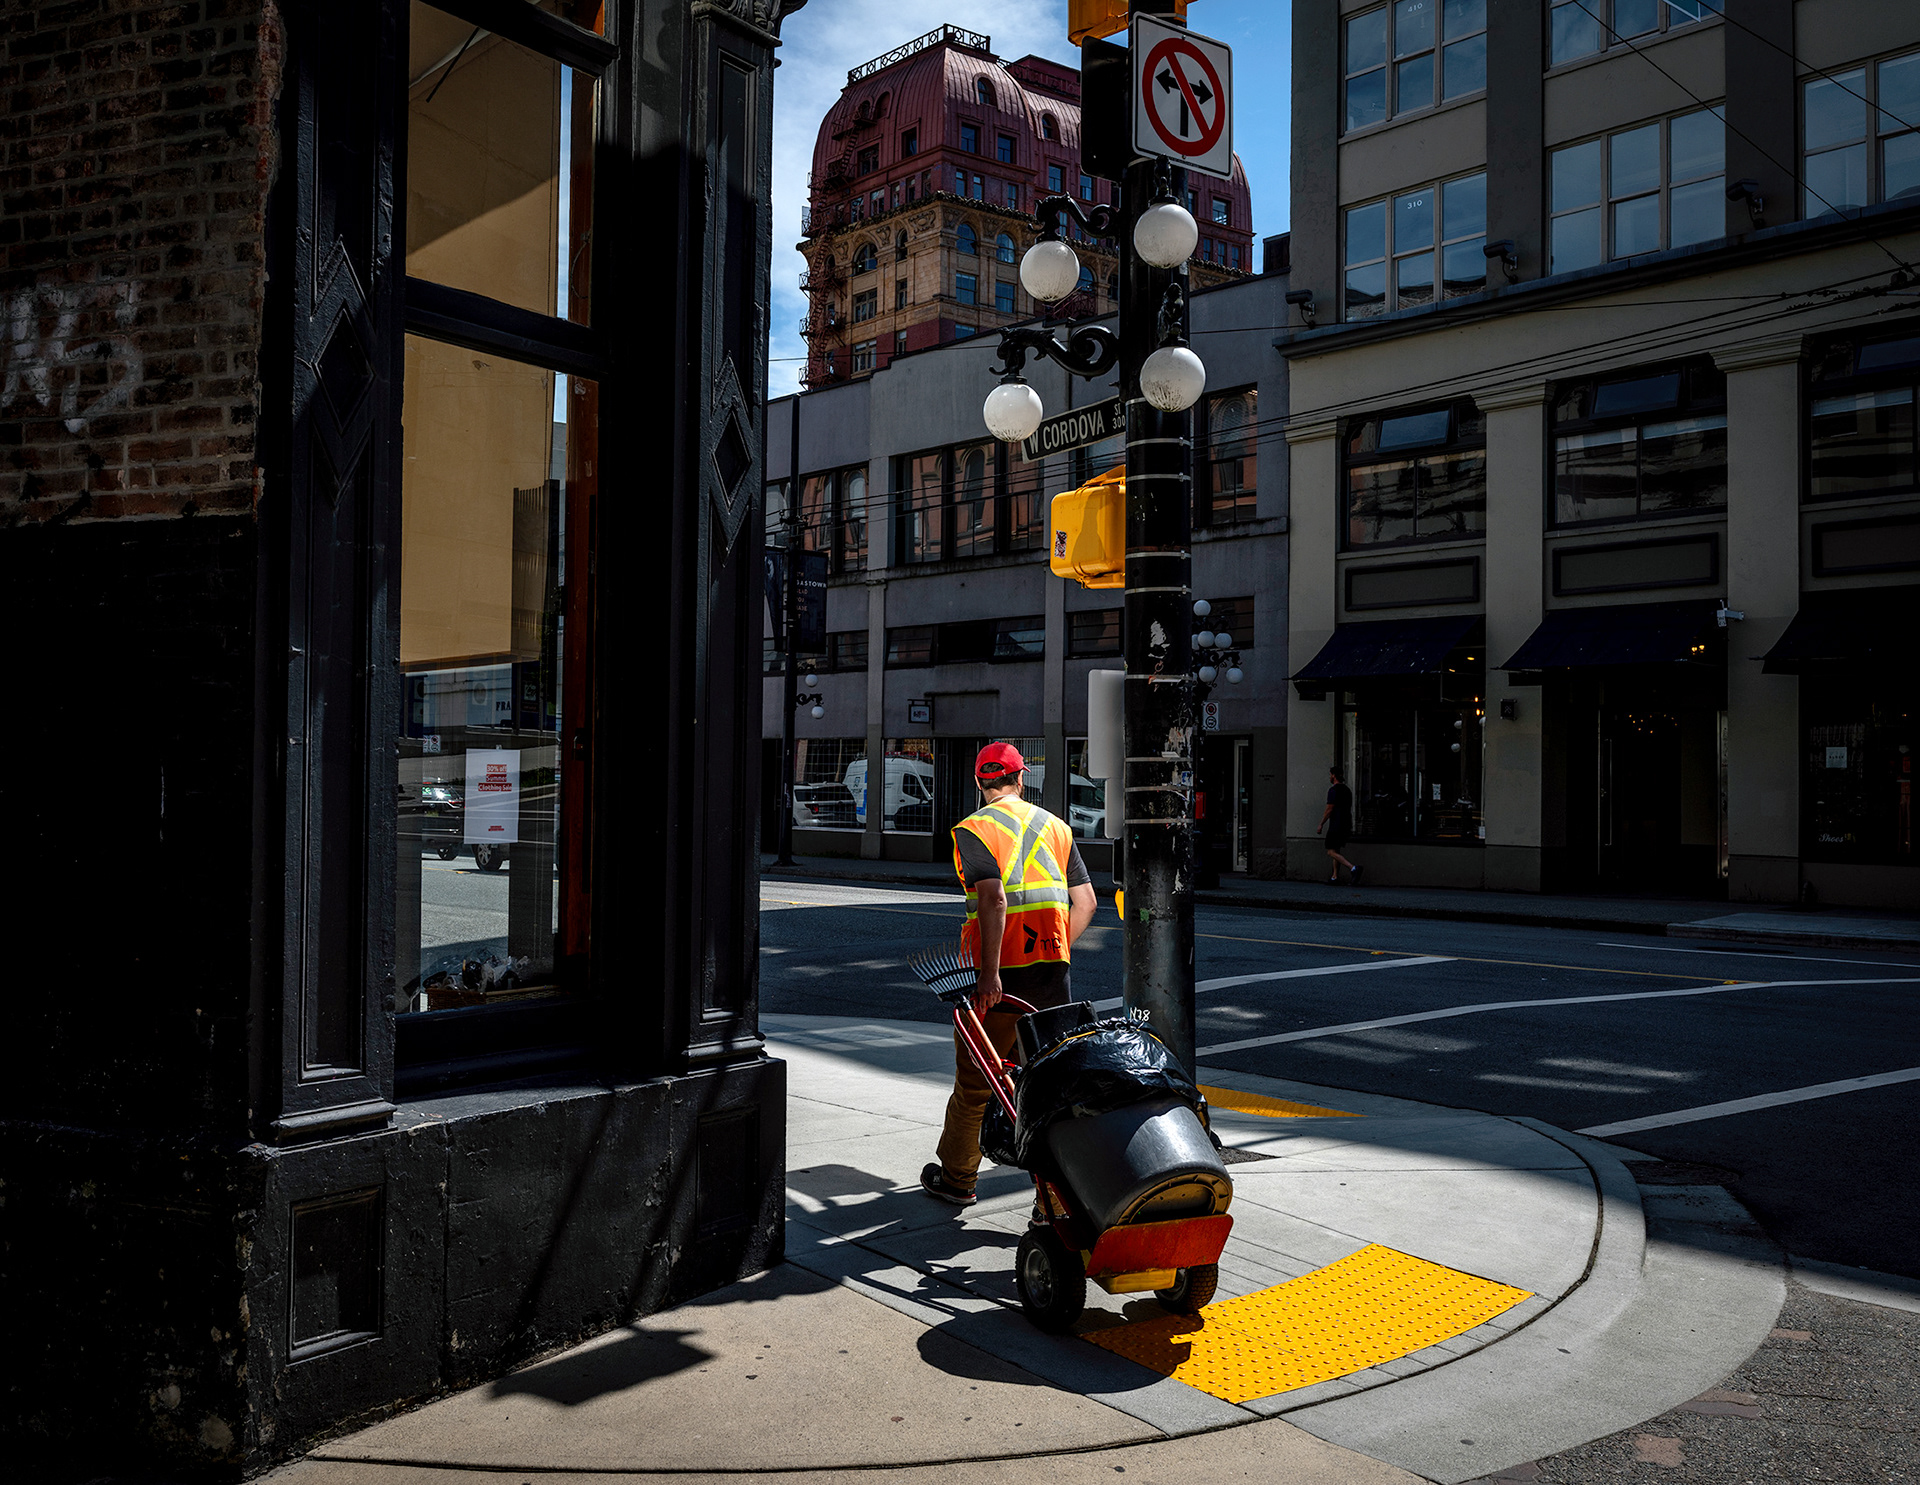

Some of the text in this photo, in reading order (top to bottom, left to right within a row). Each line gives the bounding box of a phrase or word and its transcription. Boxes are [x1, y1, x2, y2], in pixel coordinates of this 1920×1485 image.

[1408, 2, 1423, 12] 410
[1407, 199, 1423, 210] 310
[1114, 402, 1121, 416] ST
[1028, 409, 1105, 454] W CORDOVA
